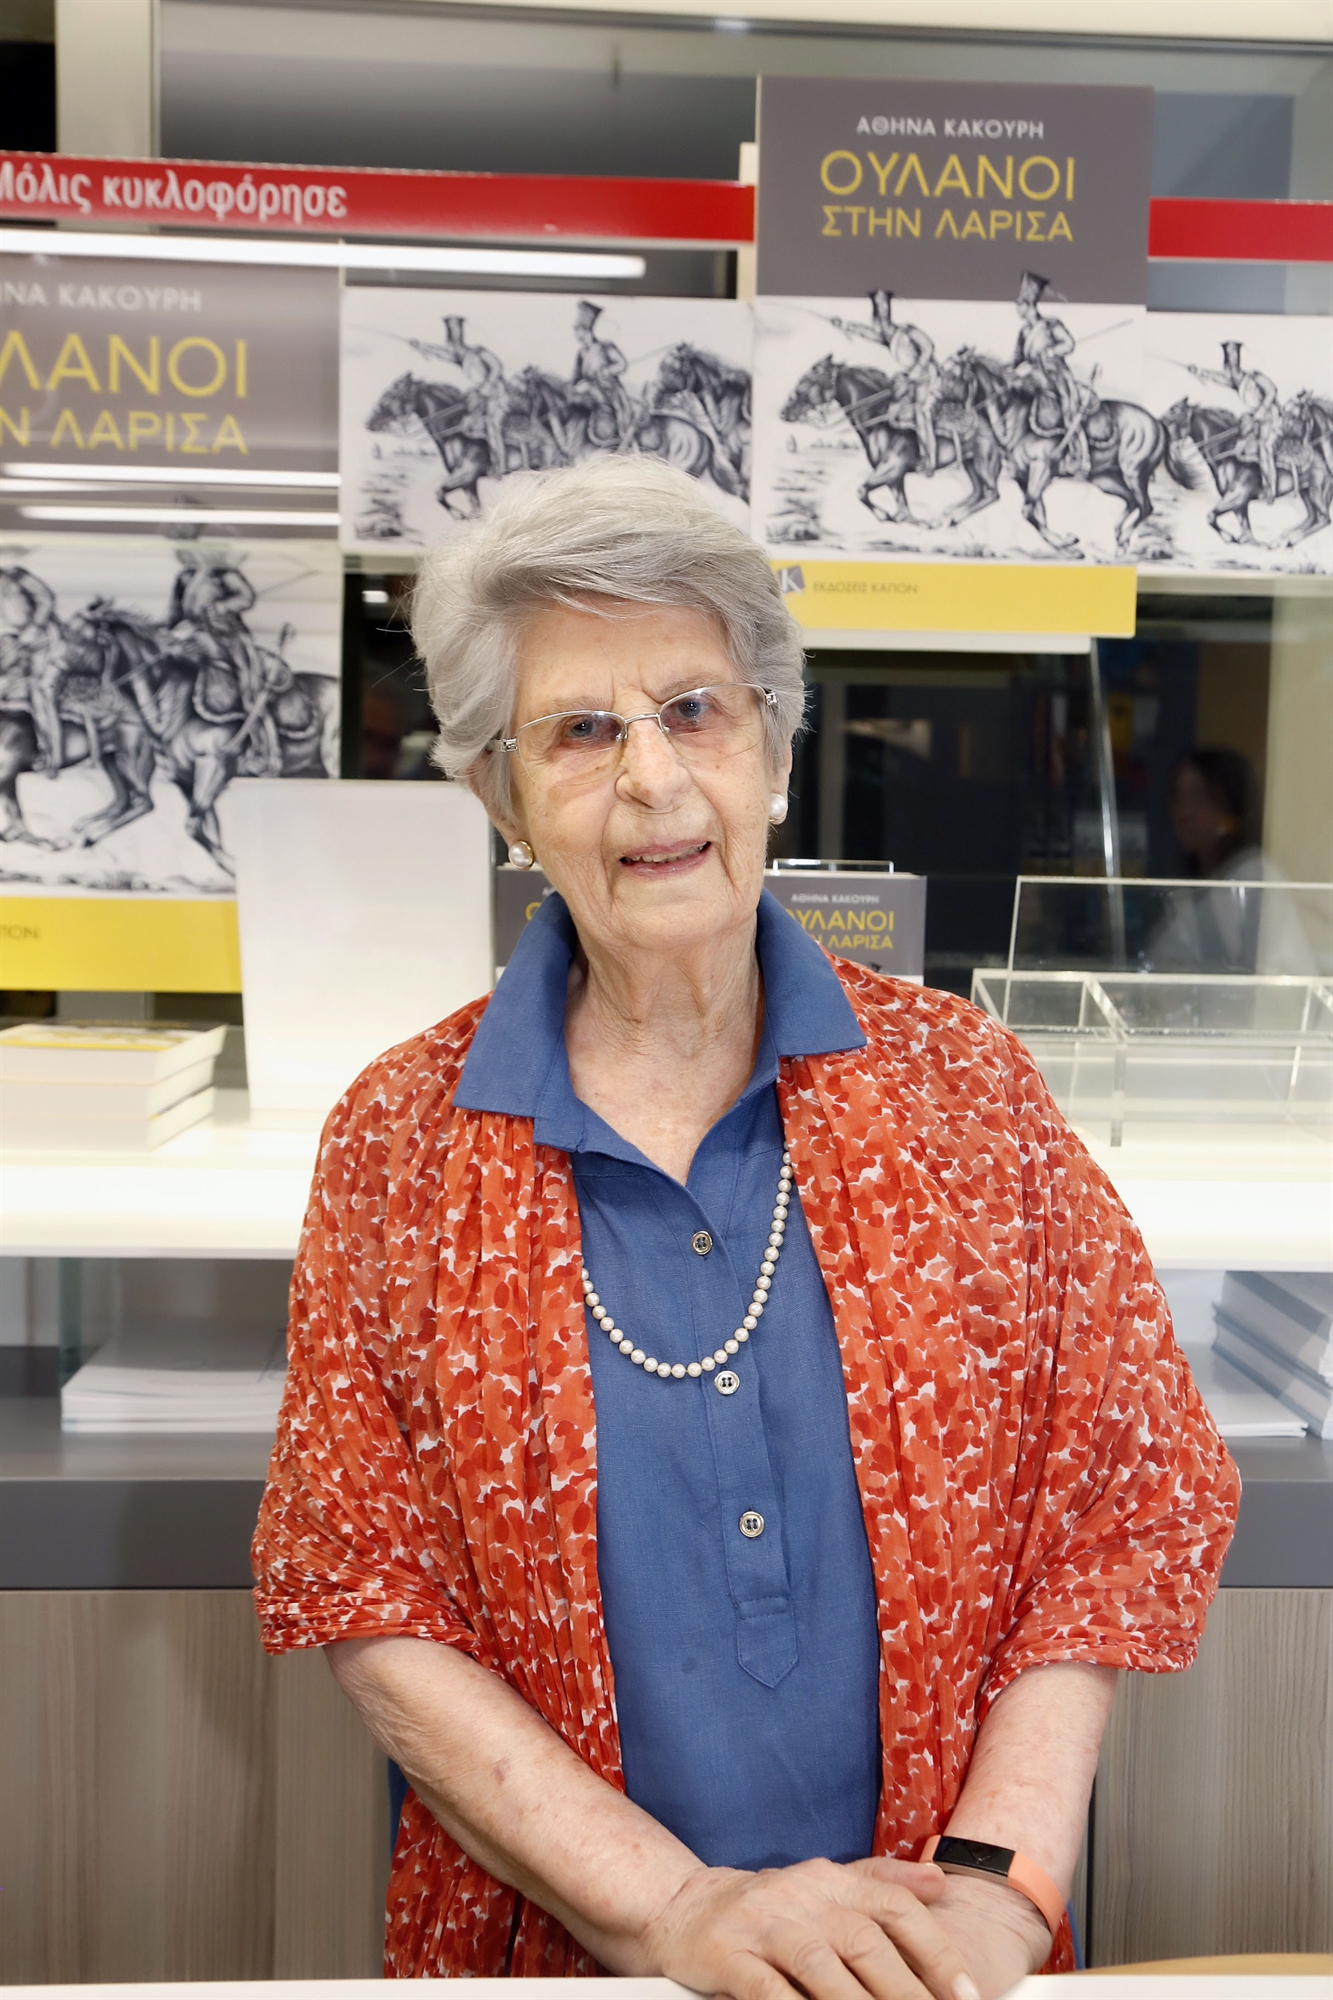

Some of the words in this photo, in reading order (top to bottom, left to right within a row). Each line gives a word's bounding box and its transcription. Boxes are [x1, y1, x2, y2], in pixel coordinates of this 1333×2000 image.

[856, 115, 936, 136] ΑΘΗΝΑ
[944, 118, 1045, 140] ΚΑΚΟΥΡΗ
[820, 150, 1074, 201] ΟΥΛΑΝΟΙ
[102, 169, 348, 224] κυκλοφόρησε
[821, 205, 922, 239] ΣΤΗΝ
[934, 208, 1074, 243] ΛΑΡΙΣΑ
[57, 282, 203, 313] ΚΑΚΟΥΡΗ
[50, 407, 249, 456] ΛΑΡΙΣΑ
[827, 934, 894, 951] ΛΑΡΙΣΑ
